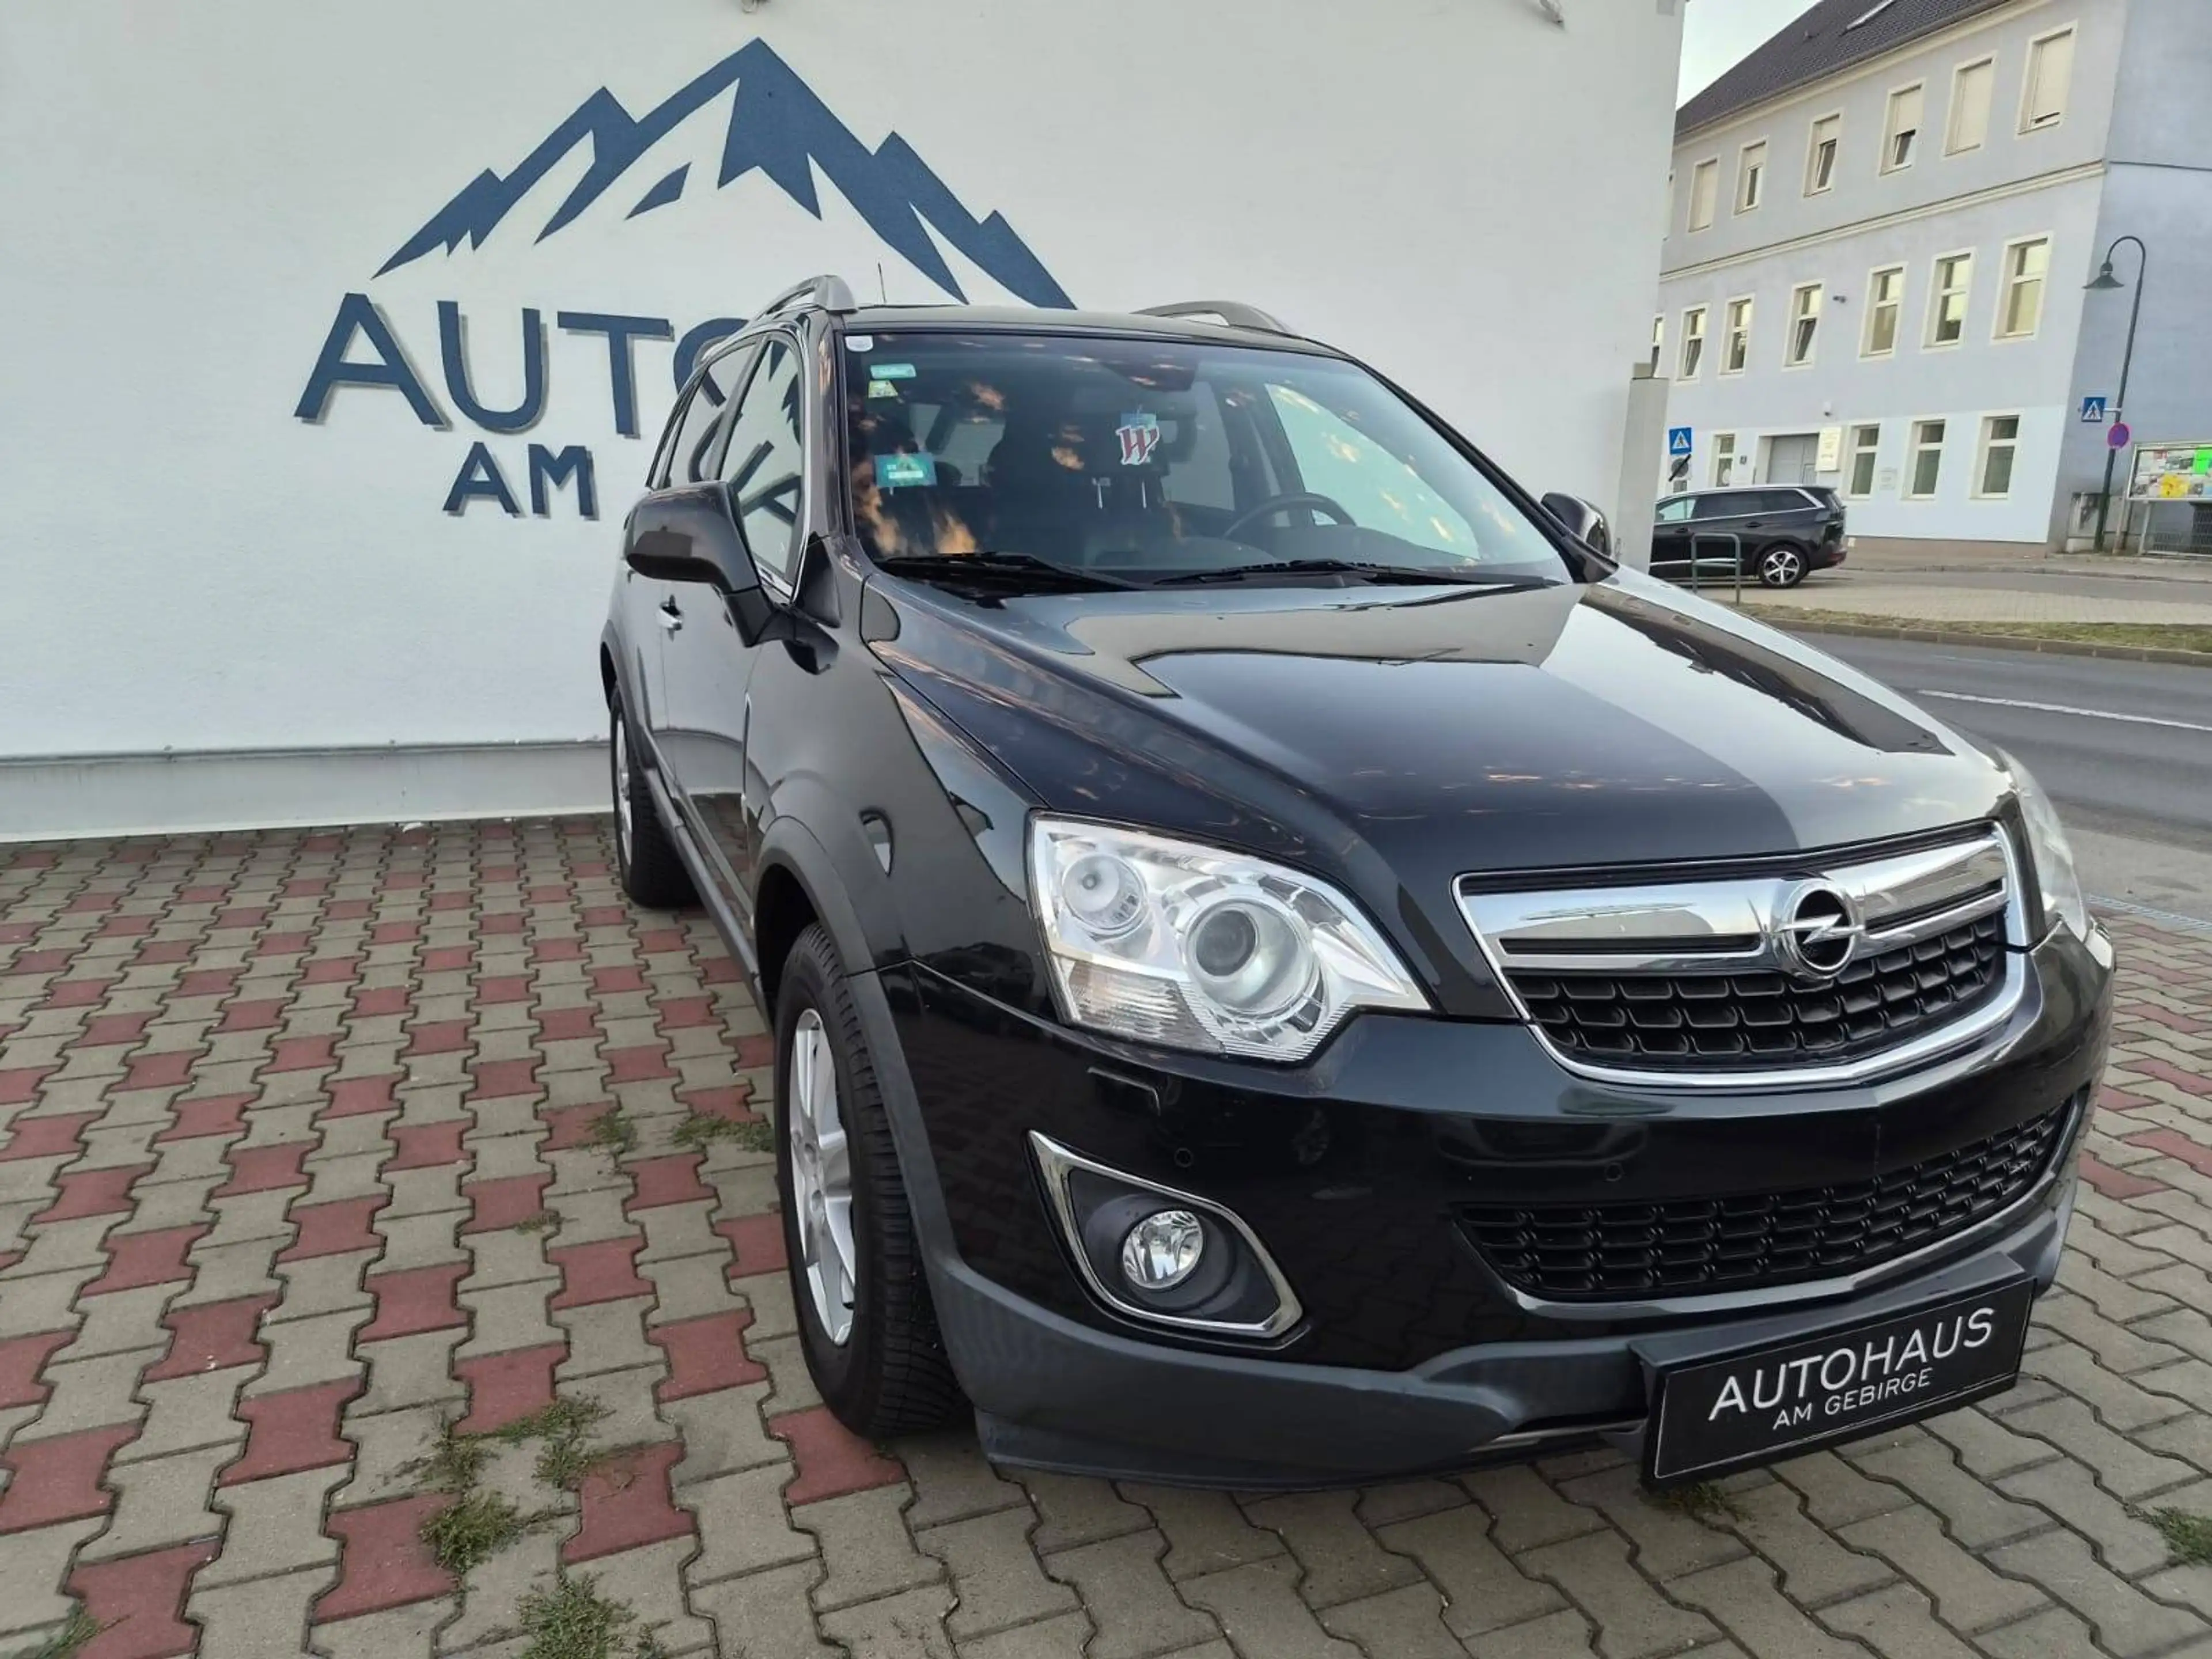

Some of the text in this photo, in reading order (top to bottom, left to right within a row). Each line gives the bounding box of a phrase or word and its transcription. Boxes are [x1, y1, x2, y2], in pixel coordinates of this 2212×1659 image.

[442, 441, 594, 516] AM
[1707, 1306, 1996, 1422] AUTOHAUS
[1772, 1366, 1933, 1430] AM GEBIRGE
